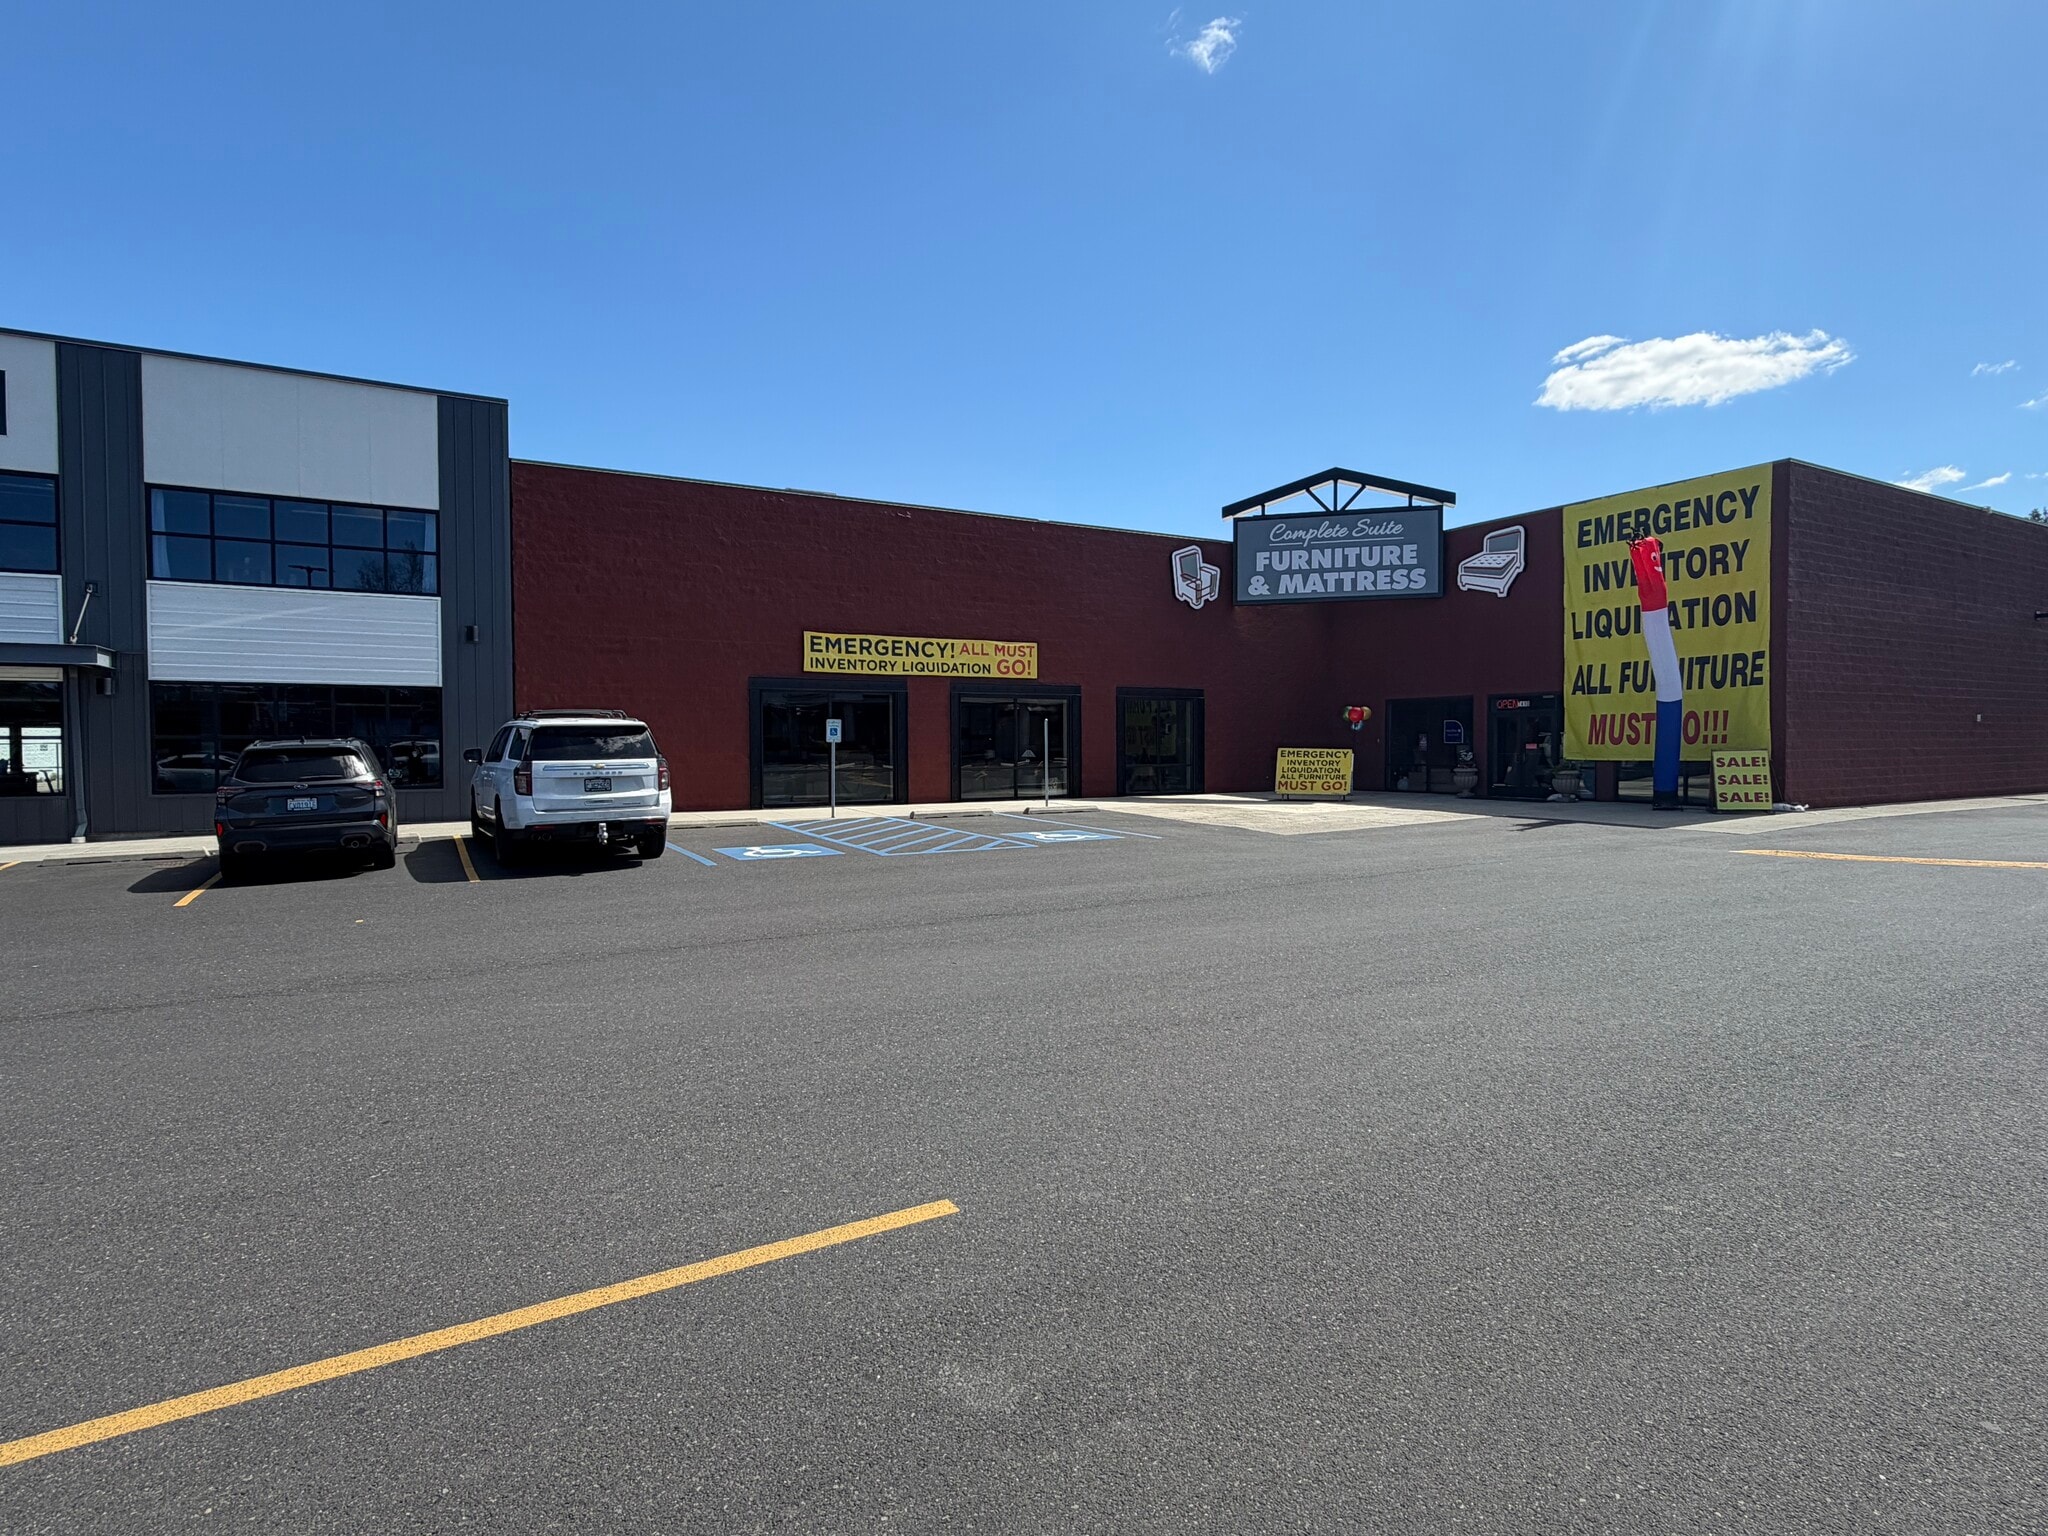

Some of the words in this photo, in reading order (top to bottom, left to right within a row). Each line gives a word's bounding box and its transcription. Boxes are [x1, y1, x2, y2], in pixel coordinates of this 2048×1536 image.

[1577, 484, 1761, 549] EMERGENCY
[1269, 520, 1349, 548] Complete
[1352, 518, 1405, 538] Suite
[1255, 543, 1418, 573] FURNITURE
[1247, 574, 1272, 596] &
[1278, 567, 1427, 595] MATTRESS
[1571, 590, 1757, 640] LIQUIATION
[809, 635, 956, 660] EMERGENCY!
[958, 642, 990, 657] ALL
[993, 643, 1036, 658] MUST
[809, 656, 898, 673] INVENTORY
[901, 660, 992, 675] LIQUIDATION
[996, 658, 1032, 676] GO!
[1571, 663, 1612, 696] ALL
[1618, 650, 1766, 694] FUITURE
[1496, 699, 1519, 709] OPEN
[1587, 711, 1657, 746] MUST
[1682, 709, 1730, 746] O!!!
[1280, 749, 1350, 759] EMERGENCY
[1286, 759, 1341, 767] INVENTORY
[1716, 756, 1767, 768] SALE!
[1281, 766, 1341, 774] LIQUIDATION
[1717, 774, 1769, 785] SALE!
[1277, 780, 1317, 791] MUST
[1321, 781, 1347, 791] GO!
[1719, 791, 1770, 803] SALE!
